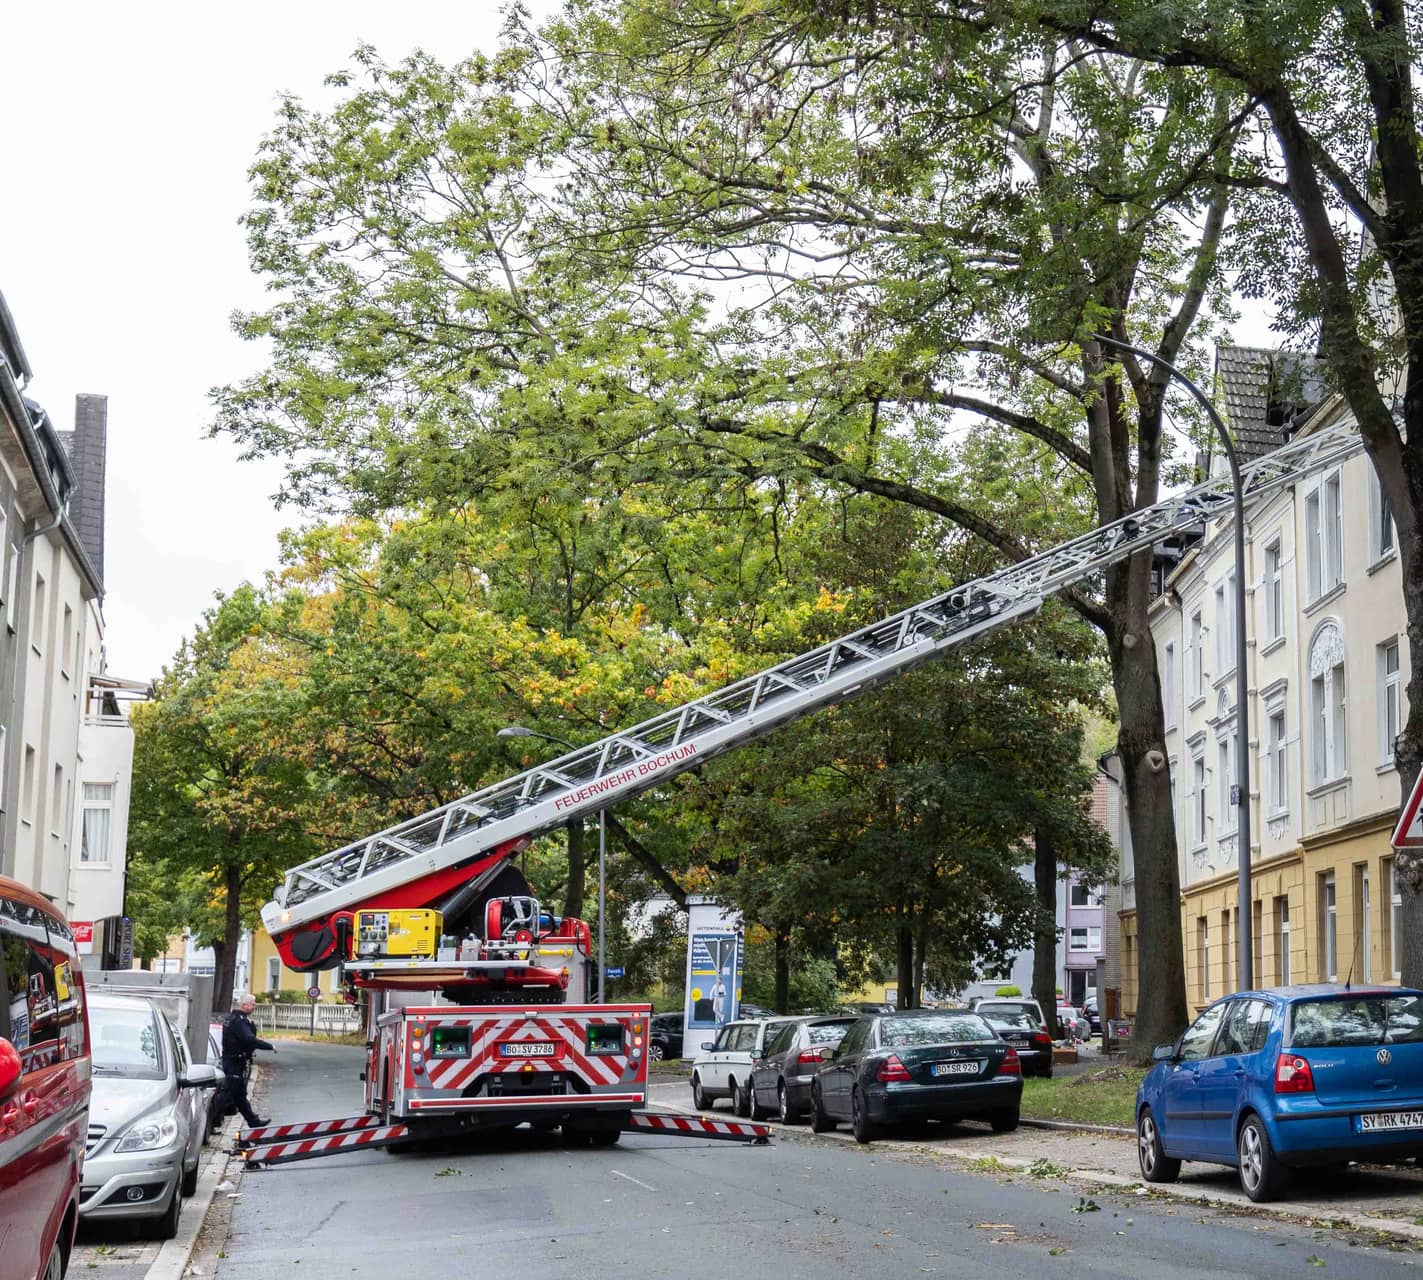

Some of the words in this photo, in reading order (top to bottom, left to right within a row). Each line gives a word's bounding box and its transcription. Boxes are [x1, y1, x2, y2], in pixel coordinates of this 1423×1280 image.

[554, 770, 637, 811] FEUERWEHR
[638, 744, 697, 776] BOCHUM
[506, 1045, 517, 1054] BO
[522, 1045, 533, 1054] SV
[936, 1065, 947, 1074] BO
[951, 1064, 962, 1073] SR
[962, 1063, 978, 1072] 926
[1363, 1115, 1376, 1129] SY
[1384, 1114, 1398, 1128] RK
